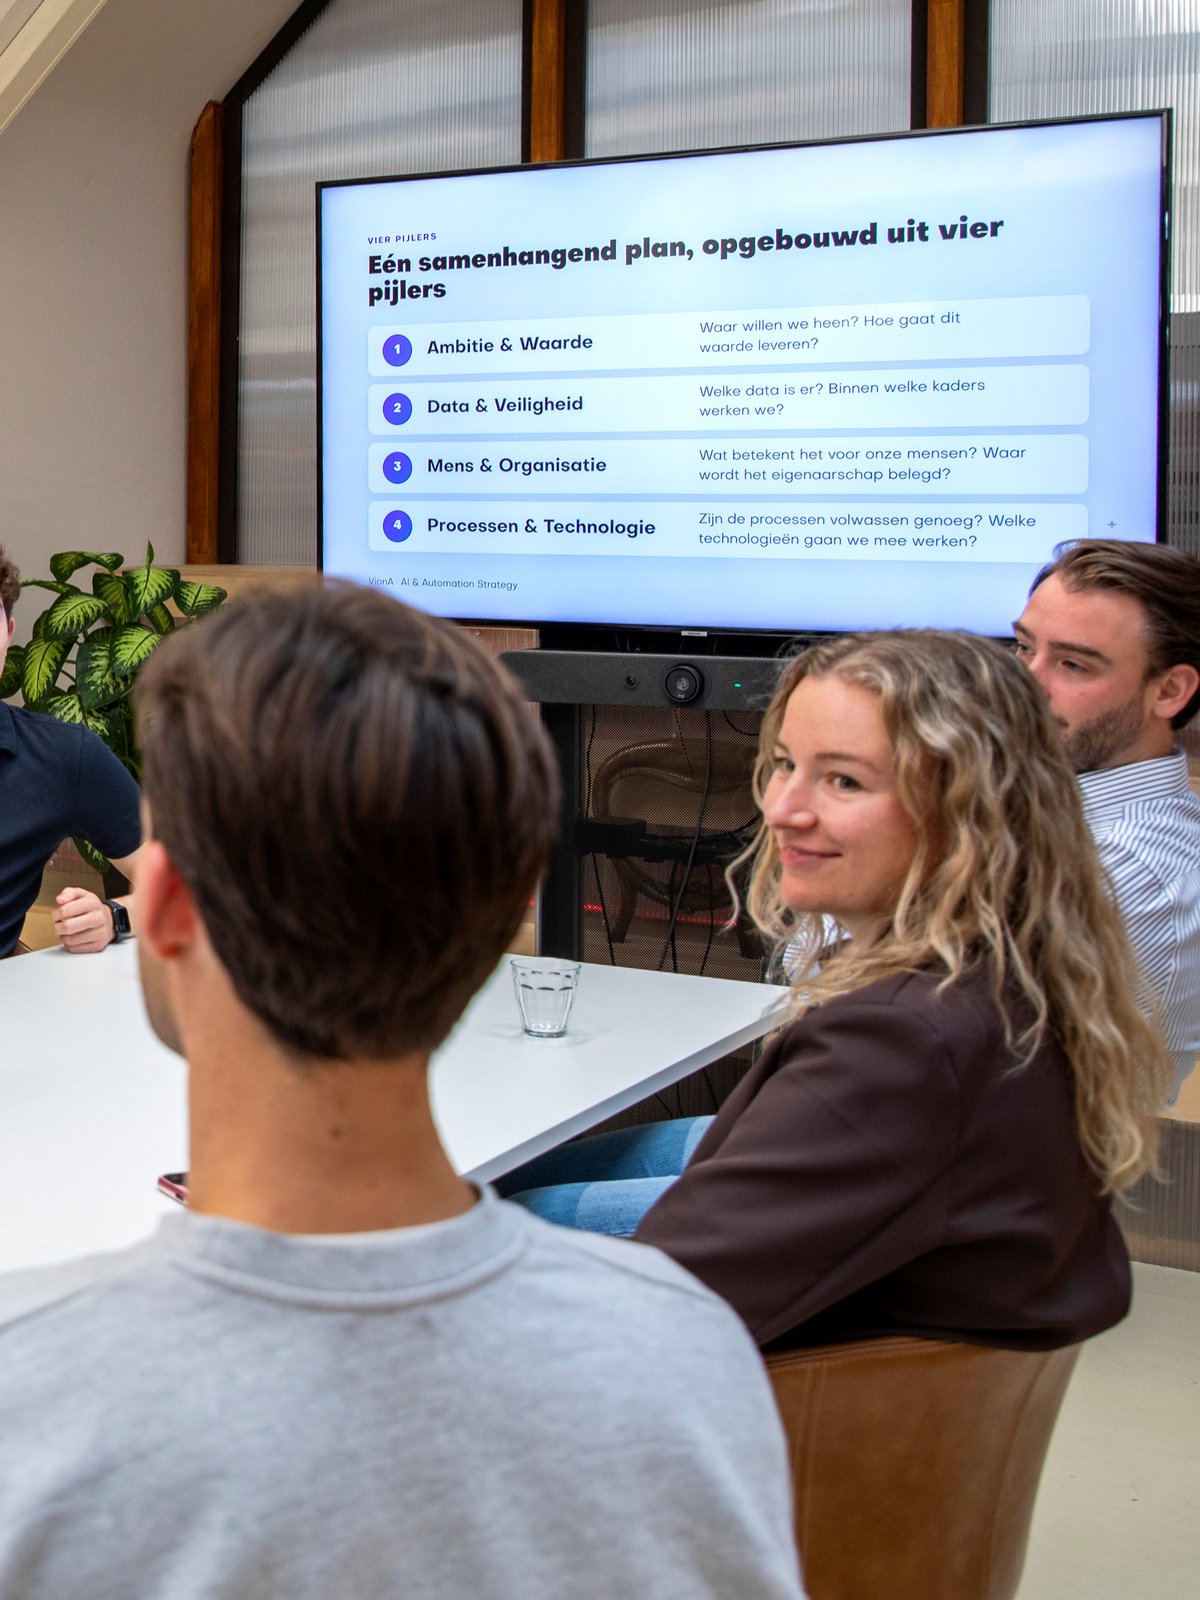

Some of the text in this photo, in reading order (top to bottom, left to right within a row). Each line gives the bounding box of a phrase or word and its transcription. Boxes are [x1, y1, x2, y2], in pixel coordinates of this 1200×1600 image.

[367, 232, 437, 245] VIER PIJLERS
[368, 214, 1005, 275] Eén samenhangend plan, opgebouwd uit vier
[368, 278, 447, 307] pijlers
[699, 311, 961, 334] Waar willen we heen? Hoe gaat dit
[394, 344, 400, 354] 1
[427, 334, 593, 355] Ambitie & Waarde
[699, 337, 819, 353] waarde leveren?
[699, 379, 986, 398] Welke data is er? Binnen welke kaders
[393, 402, 402, 413] 2
[427, 395, 583, 416] Data & Veiligheid
[699, 403, 785, 417] werken we?
[699, 446, 1027, 461] Wat betekent het voor onze mensen? Waar
[393, 460, 402, 472] 3
[427, 456, 607, 477] Mens & Organisatie
[698, 467, 951, 484] wordt het eigenaarschap belegd?
[393, 519, 402, 530] 4
[427, 518, 656, 539] Processen & Technologie
[698, 512, 1037, 530] Zijn de processen volwassen genoeg? Welke
[698, 531, 978, 549] technologieën gaan we mee werken?
[400, 577, 410, 586] AI
[411, 577, 419, 587] &
[421, 578, 475, 589] Automation
[477, 579, 518, 592] Strategy
